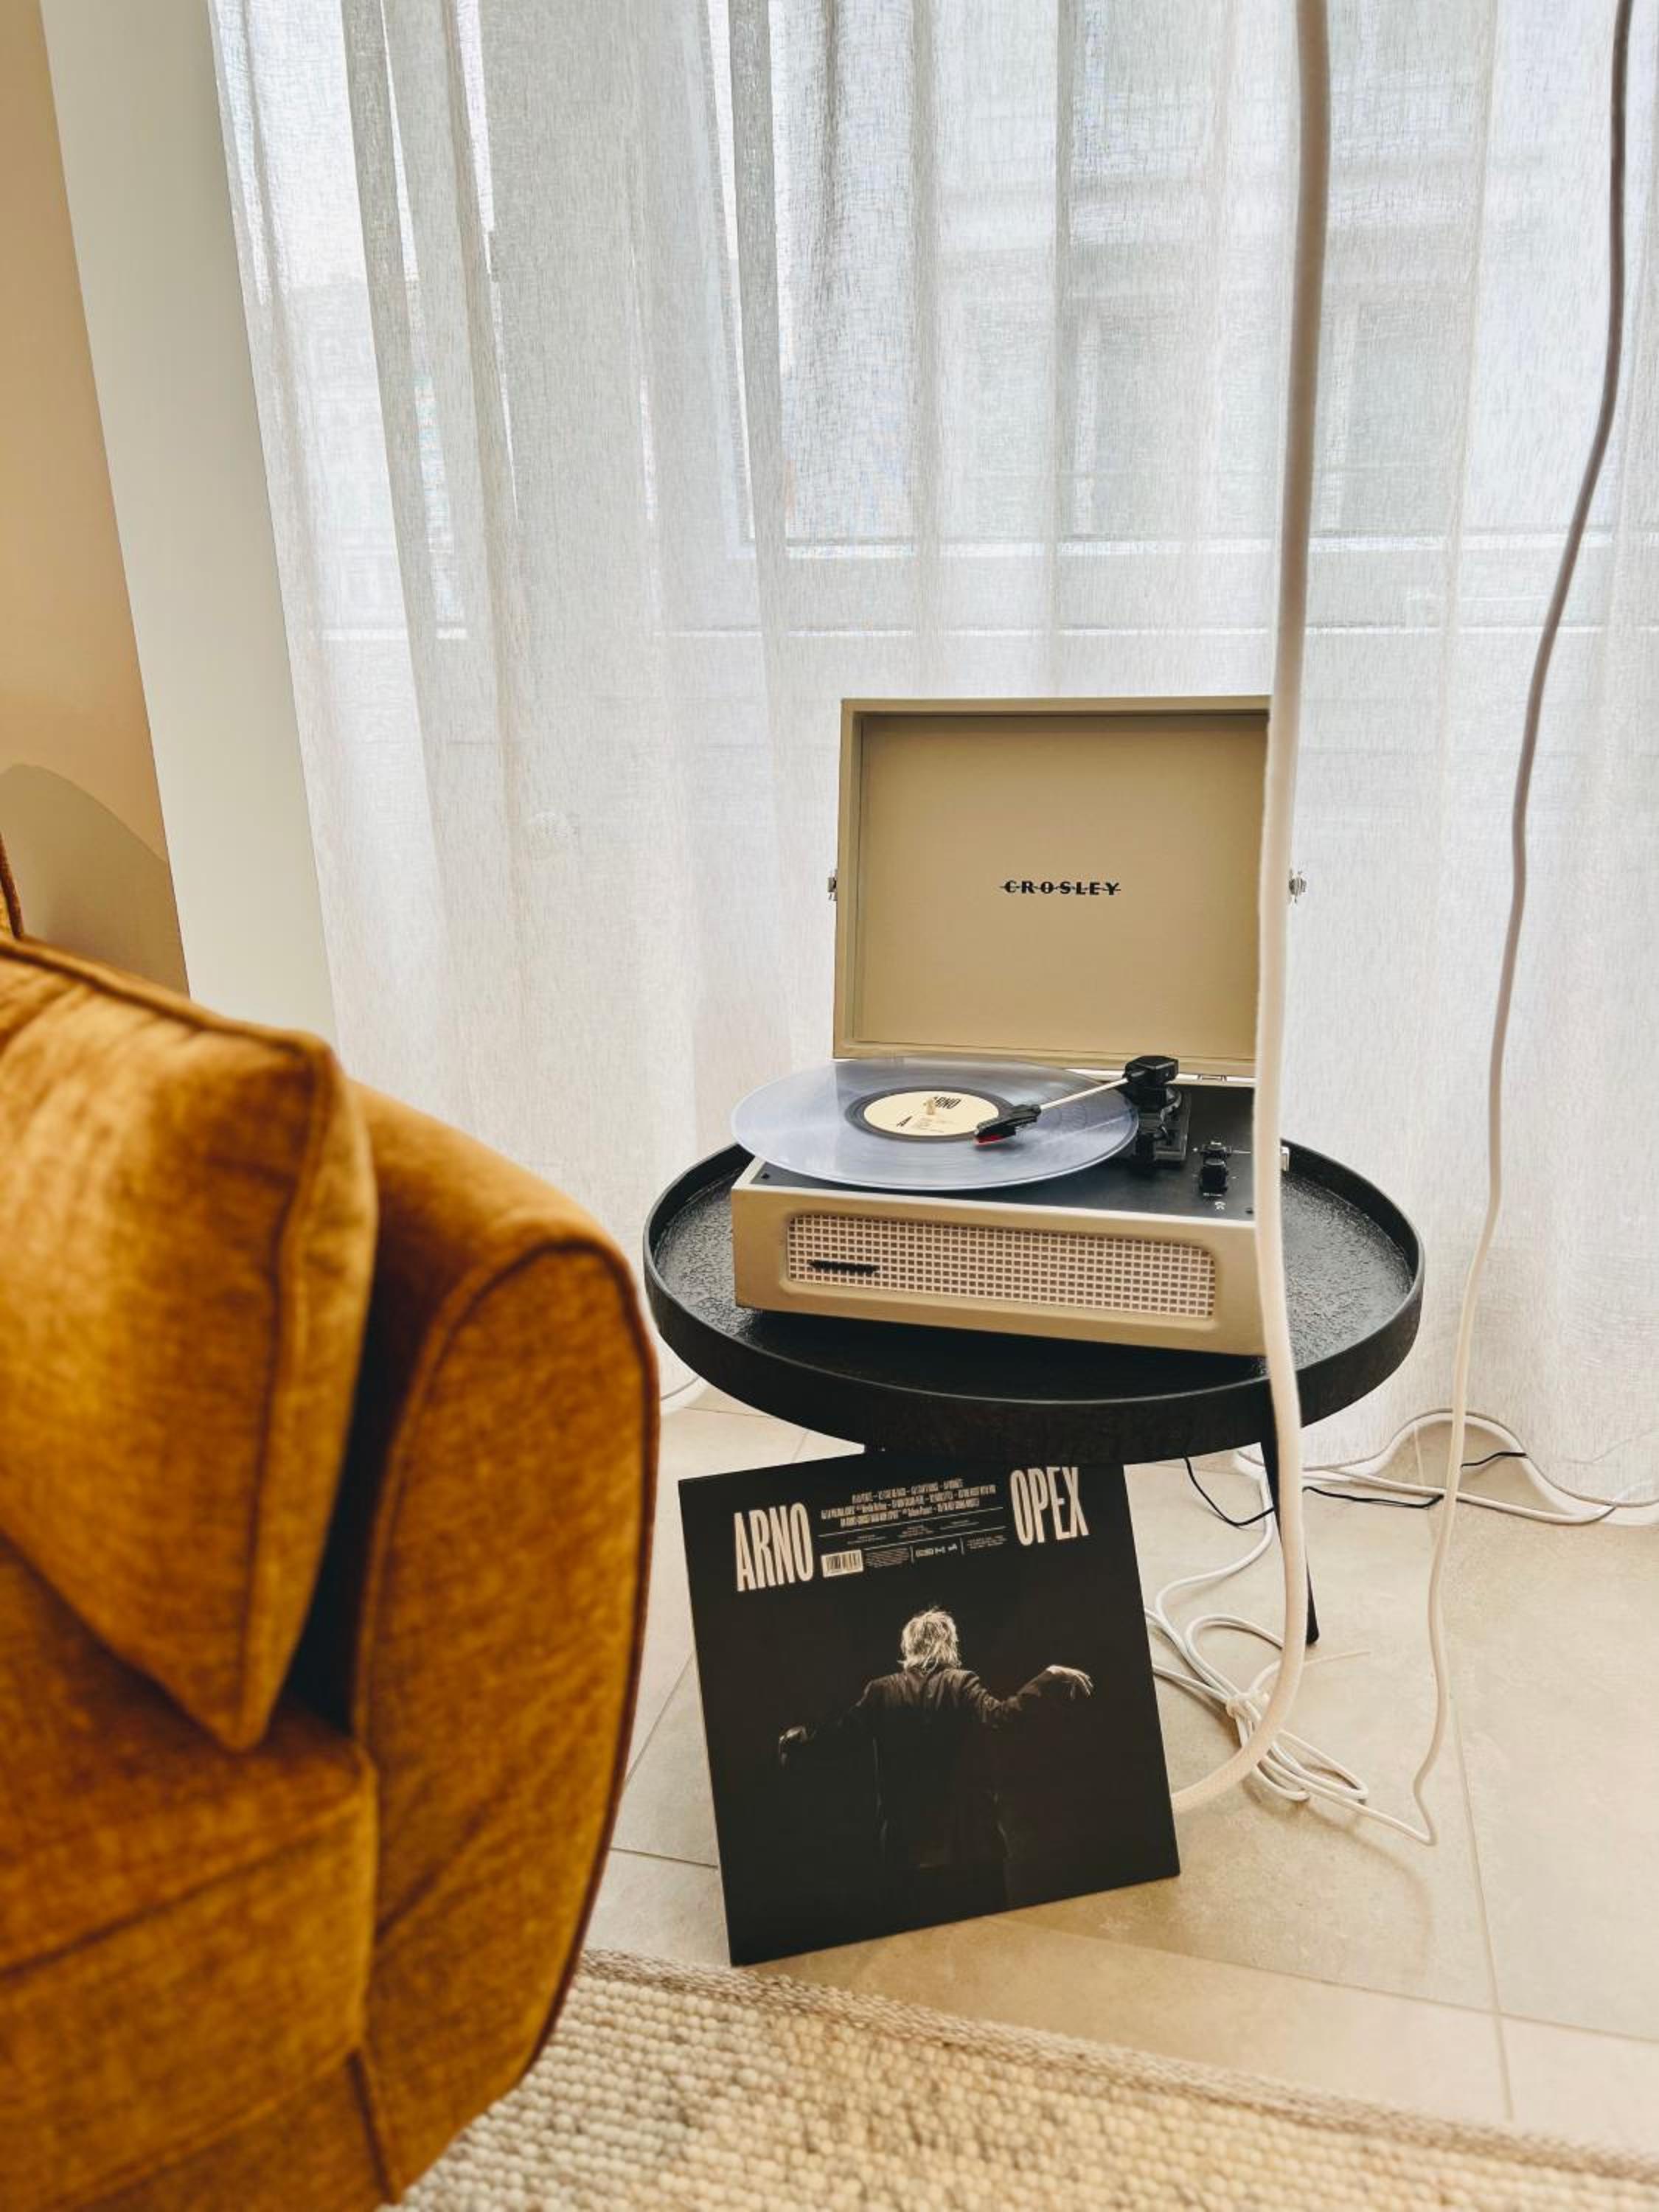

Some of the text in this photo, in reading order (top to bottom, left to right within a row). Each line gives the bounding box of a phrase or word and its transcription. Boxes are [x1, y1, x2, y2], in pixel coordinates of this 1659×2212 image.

[1000, 880, 1121, 895] CROSLEY
[734, 1502, 813, 1592] ARNO
[1010, 1466, 1089, 1546] OPEX
